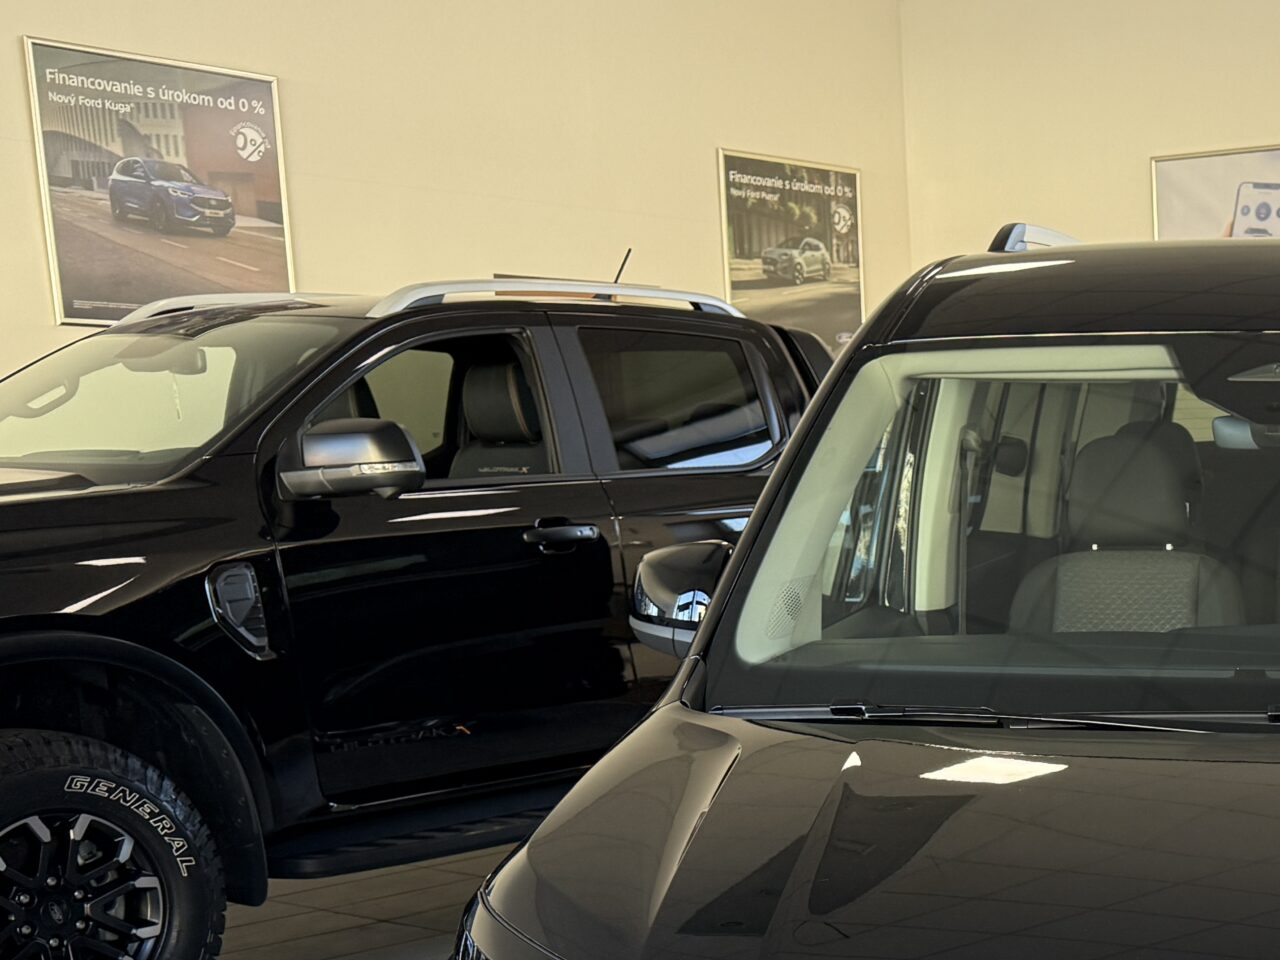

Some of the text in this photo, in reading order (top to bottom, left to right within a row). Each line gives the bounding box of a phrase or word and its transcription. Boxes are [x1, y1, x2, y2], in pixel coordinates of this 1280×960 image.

[45, 68, 265, 115] Financovanie s úrokom od 0 %
[48, 91, 76, 106] Nový
[78, 96, 102, 108] Ford
[729, 170, 783, 189] Financovanie
[784, 180, 790, 190] s
[824, 184, 835, 196] od
[836, 185, 843, 197] 0
[63, 775, 196, 877] GENERAL
